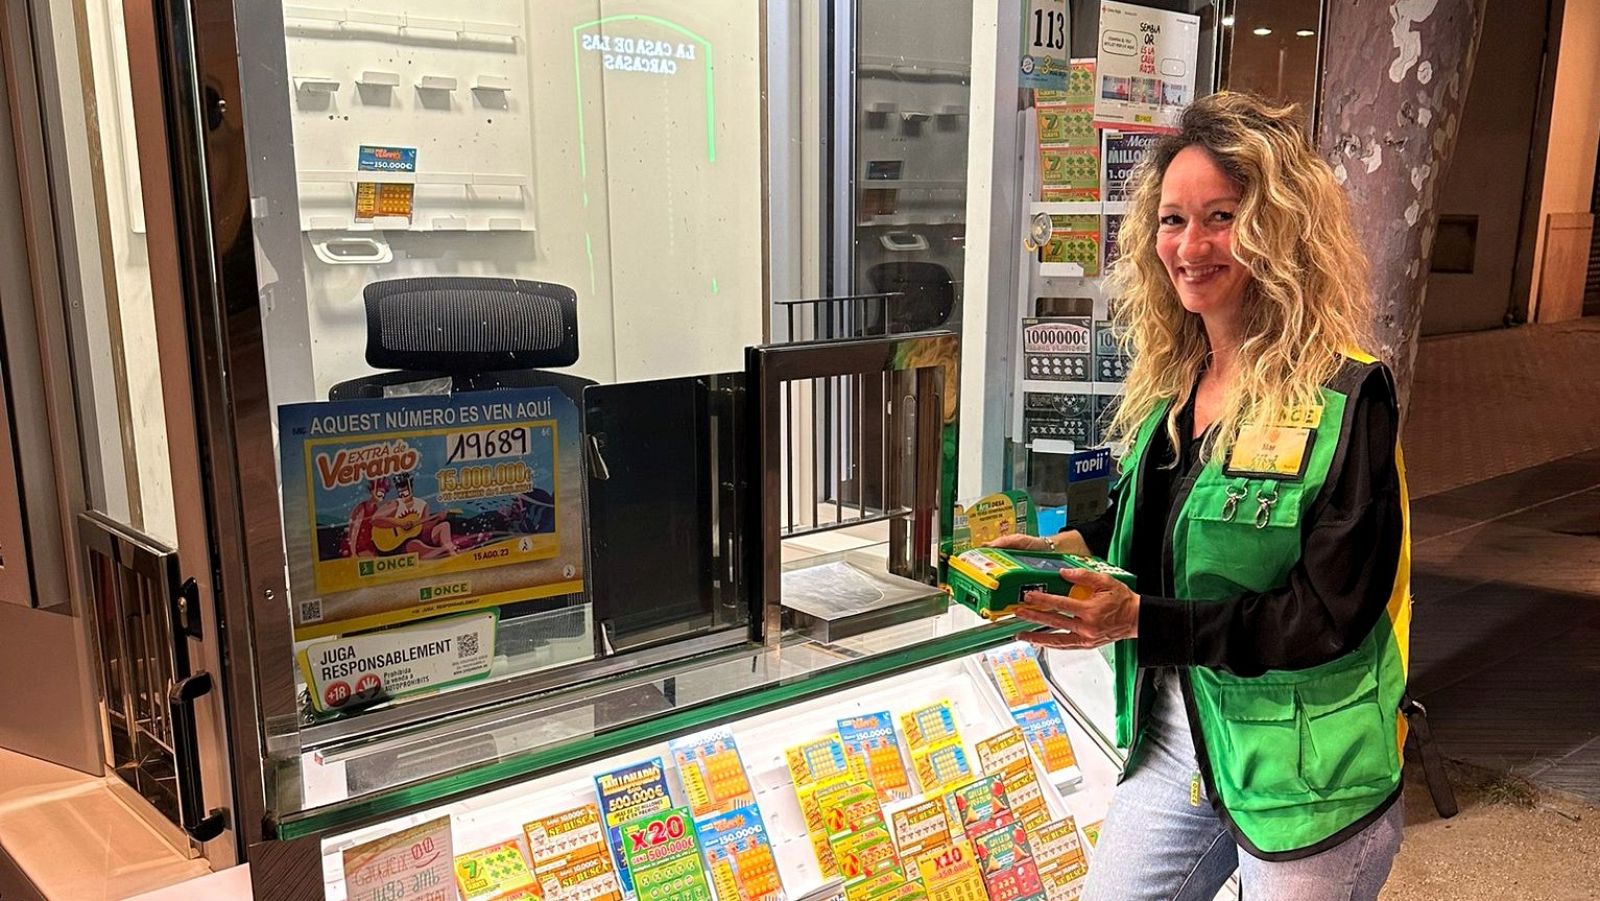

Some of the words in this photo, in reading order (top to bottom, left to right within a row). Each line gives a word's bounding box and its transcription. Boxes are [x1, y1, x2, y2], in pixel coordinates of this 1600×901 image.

[1033, 9, 1064, 49] 113
[1144, 33, 1155, 45] OR
[1026, 330, 1088, 345] 1000000€
[310, 413, 380, 435] AQUEST
[385, 407, 456, 428] NÚMERO
[460, 406, 478, 423] ES
[482, 403, 512, 420] VEN
[517, 396, 551, 418] AQUÍ
[348, 445, 390, 463] EXTRA
[393, 443, 406, 454] de
[445, 428, 527, 466] 19689
[318, 450, 417, 488] Verano
[437, 463, 532, 491] 15.000.000€
[376, 556, 415, 571] ONCE
[473, 552, 482, 561] 15
[500, 548, 509, 557] 23
[434, 583, 468, 596] ONCE
[320, 645, 356, 666] JUGA
[322, 639, 452, 681] RESPONSABLEMENT
[384, 668, 411, 678] Prohibida
[391, 675, 408, 684] venda
[327, 686, 346, 702] +18
[609, 785, 664, 811] 500.000€
[549, 826, 562, 838] SE
[563, 813, 595, 832] BUSCA
[648, 836, 694, 861] 500.000€
[562, 876, 575, 888] SE
[576, 862, 609, 881] BUSCA
